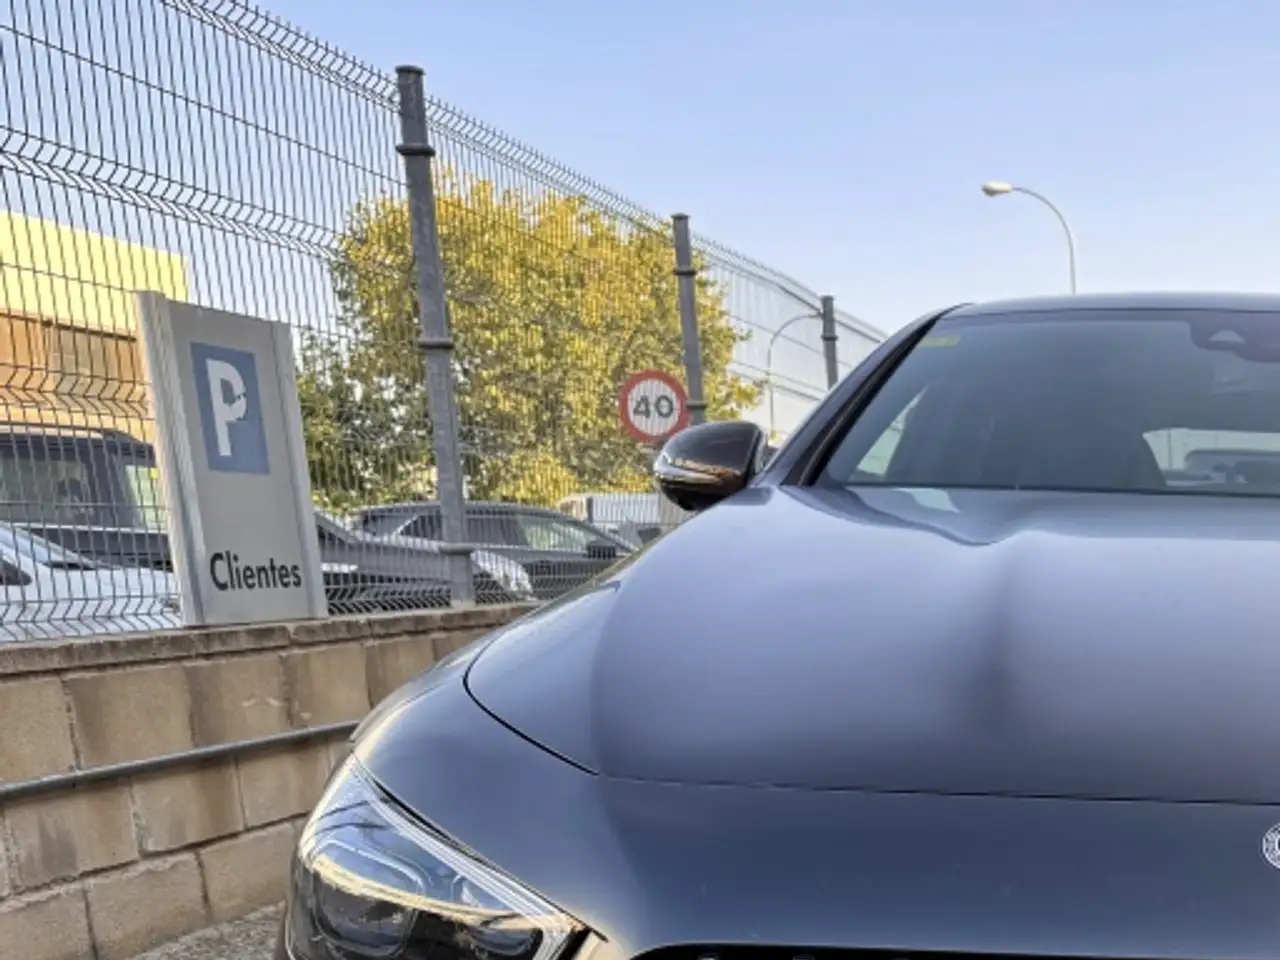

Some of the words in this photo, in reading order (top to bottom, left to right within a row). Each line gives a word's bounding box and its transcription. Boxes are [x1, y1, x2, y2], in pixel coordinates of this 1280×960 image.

[206, 357, 248, 457] P
[633, 395, 674, 419] 40
[209, 550, 302, 592] Clientes
